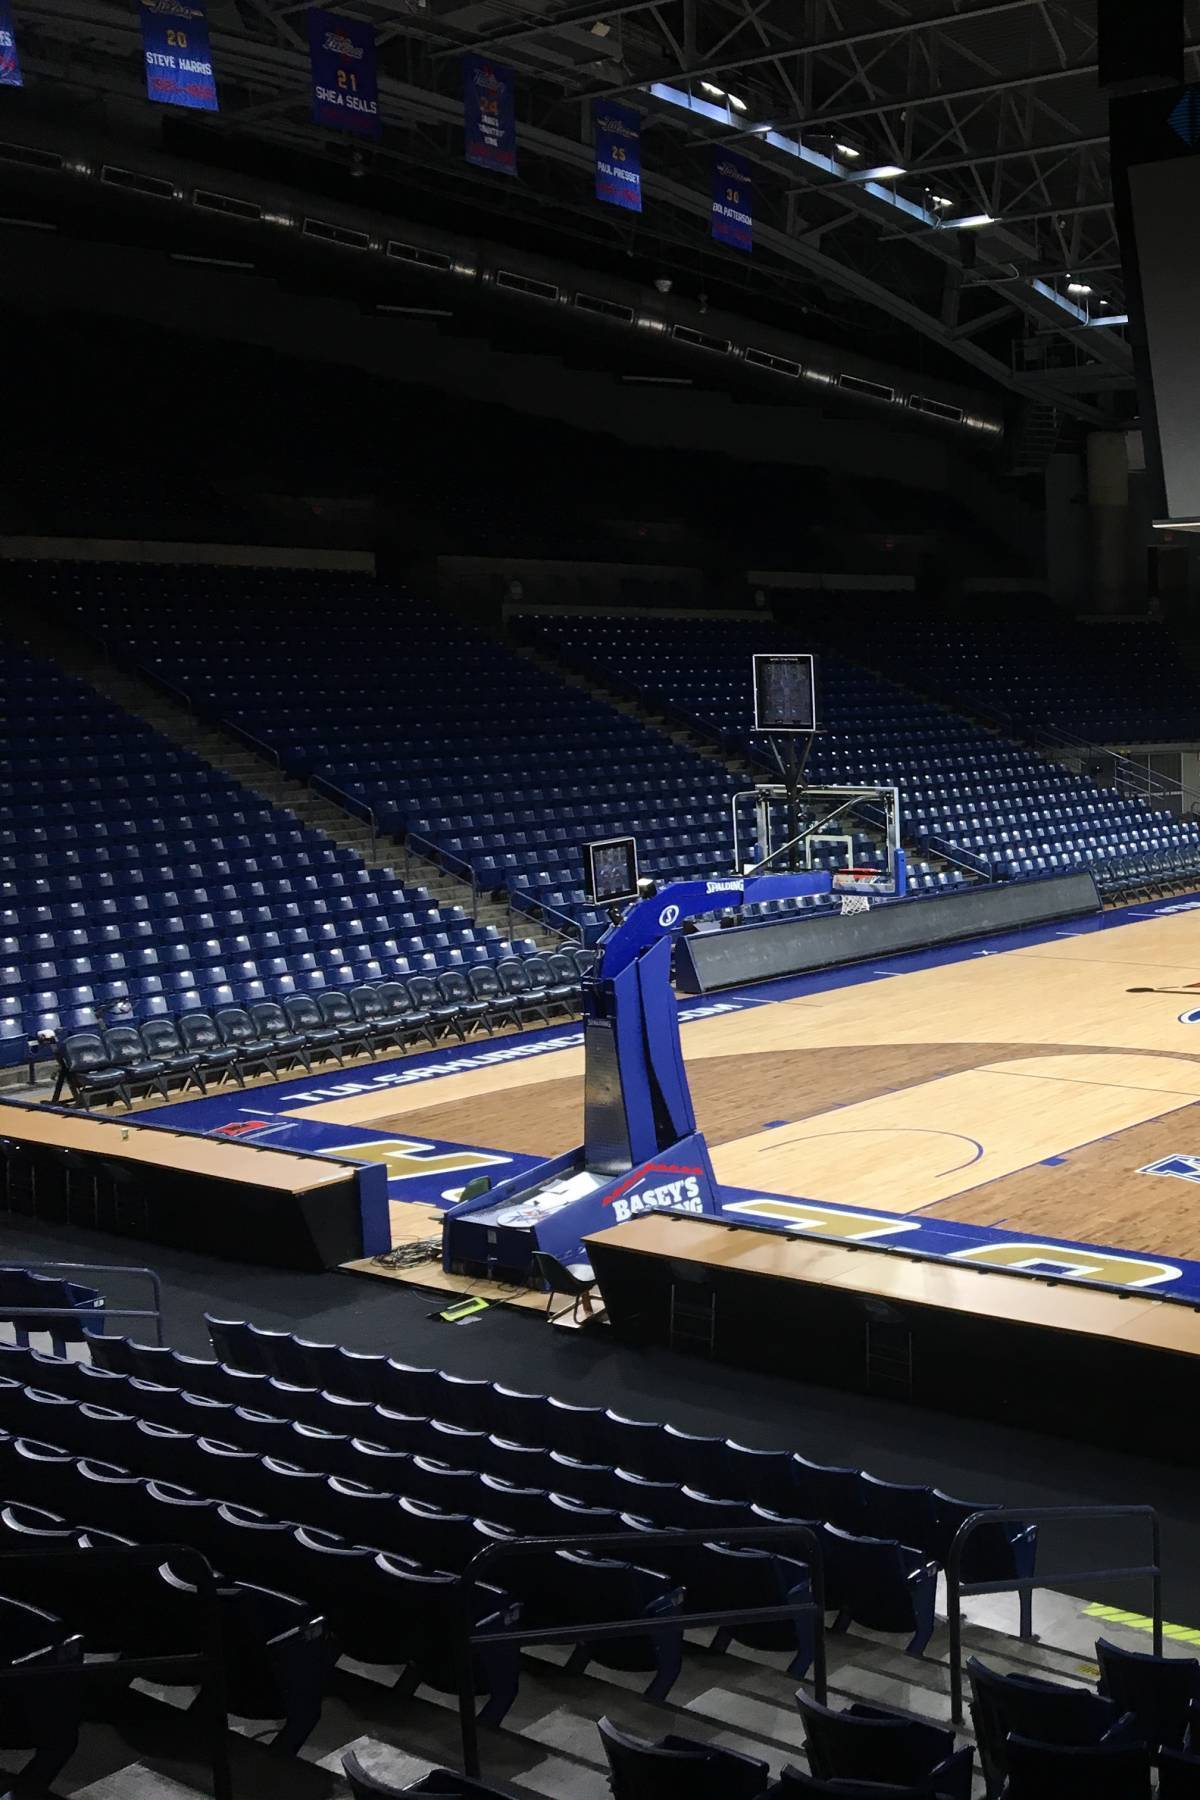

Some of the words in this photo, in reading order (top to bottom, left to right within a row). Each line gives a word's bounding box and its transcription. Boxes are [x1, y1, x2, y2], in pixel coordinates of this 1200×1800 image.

[165, 29, 188, 48] 20
[145, 51, 176, 69] STEVE
[179, 58, 213, 76] HARRIS
[336, 69, 357, 91] 21
[315, 85, 344, 106] SHEA
[346, 94, 377, 114] SEALS
[706, 880, 745, 895] SPALDING
[612, 1176, 700, 1221] BASEY'S
